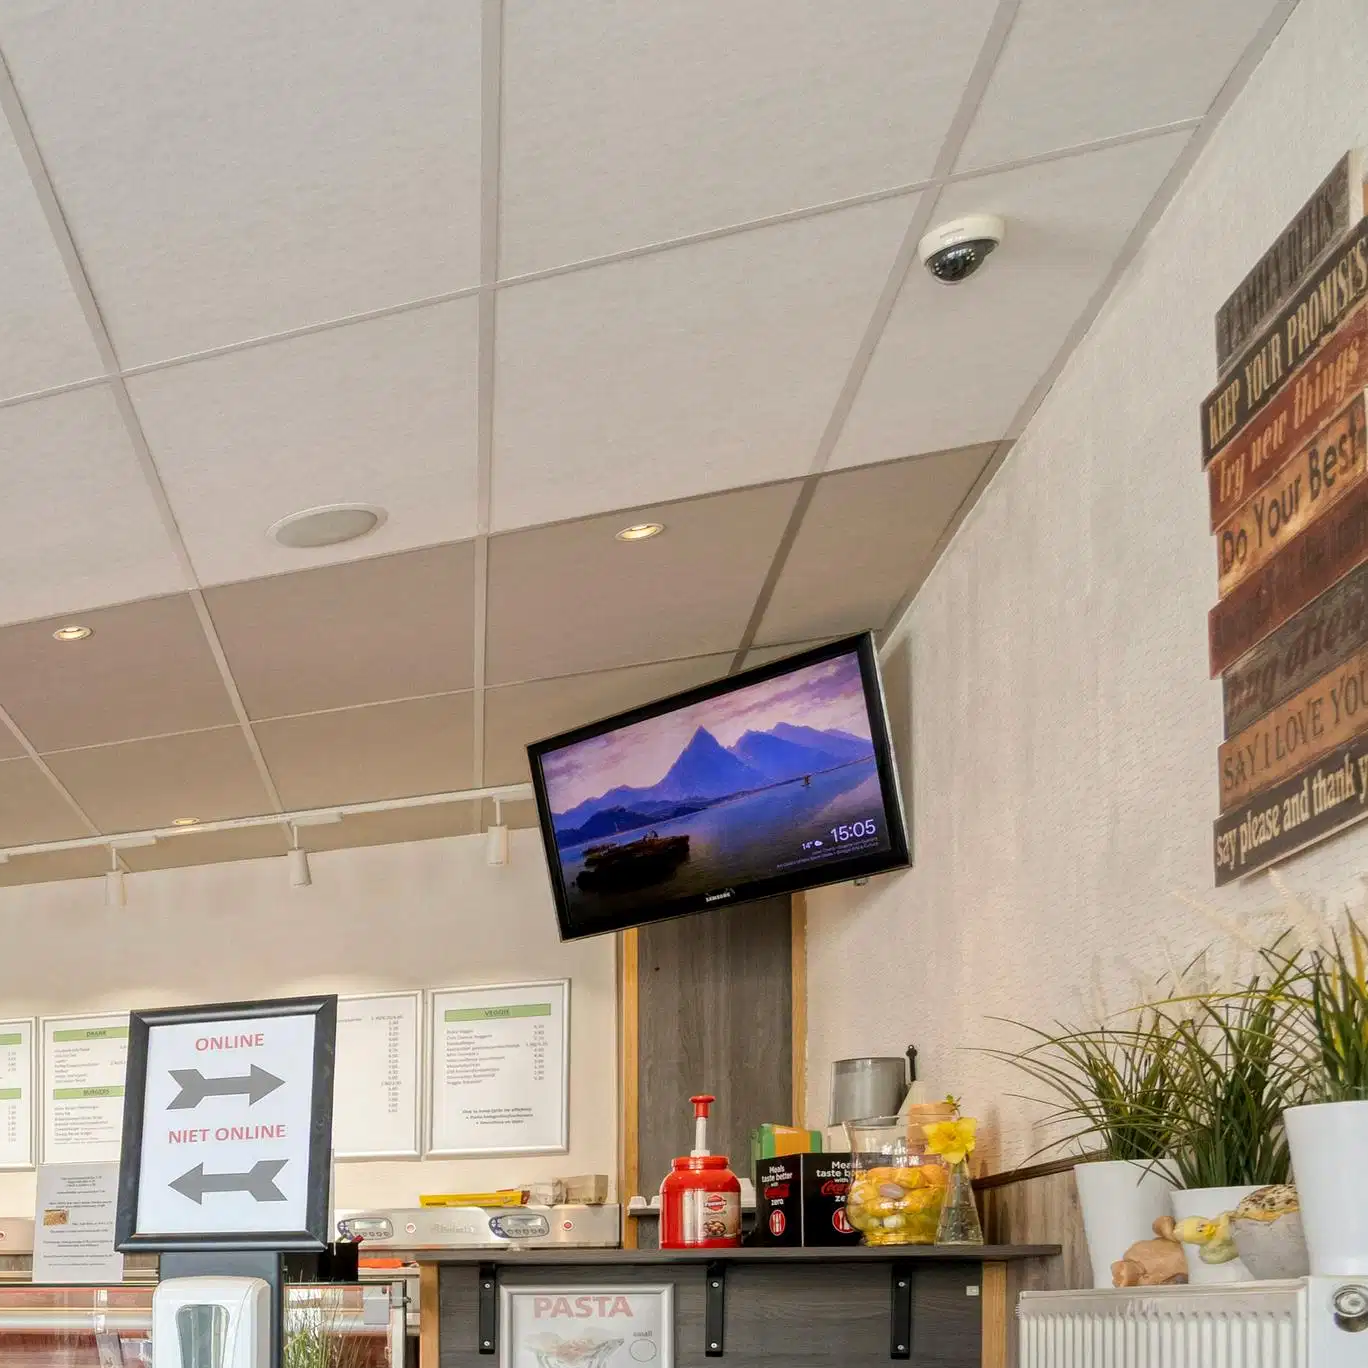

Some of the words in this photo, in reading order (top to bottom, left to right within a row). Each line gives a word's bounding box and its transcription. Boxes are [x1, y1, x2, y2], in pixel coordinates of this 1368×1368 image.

[1208, 378, 1241, 450] KEEP
[1244, 331, 1283, 411] YOUR
[1286, 236, 1368, 367] PROMISES
[1219, 452, 1246, 502] try
[1251, 409, 1288, 473] new
[1293, 335, 1361, 430] things
[1221, 527, 1248, 576] Do
[1252, 473, 1302, 548] Your
[1308, 410, 1358, 503] Best
[1222, 730, 1260, 792] SAY
[1274, 695, 1324, 761] LOVE
[1216, 826, 1238, 871] say
[1239, 808, 1281, 865] please
[1282, 775, 1310, 832] and
[1312, 750, 1356, 812] thank
[830, 819, 877, 843] 15:05
[484, 1007, 511, 1017] VEGGIE
[195, 1033, 265, 1051] ONLINE
[168, 1128, 211, 1144] NIET
[215, 1124, 287, 1141] ONLINE
[769, 1165, 785, 1173] Meals
[775, 1172, 793, 1180] better
[816, 1169, 842, 1177] taste
[532, 1295, 634, 1319] PASTA
[632, 1330, 653, 1338] small
